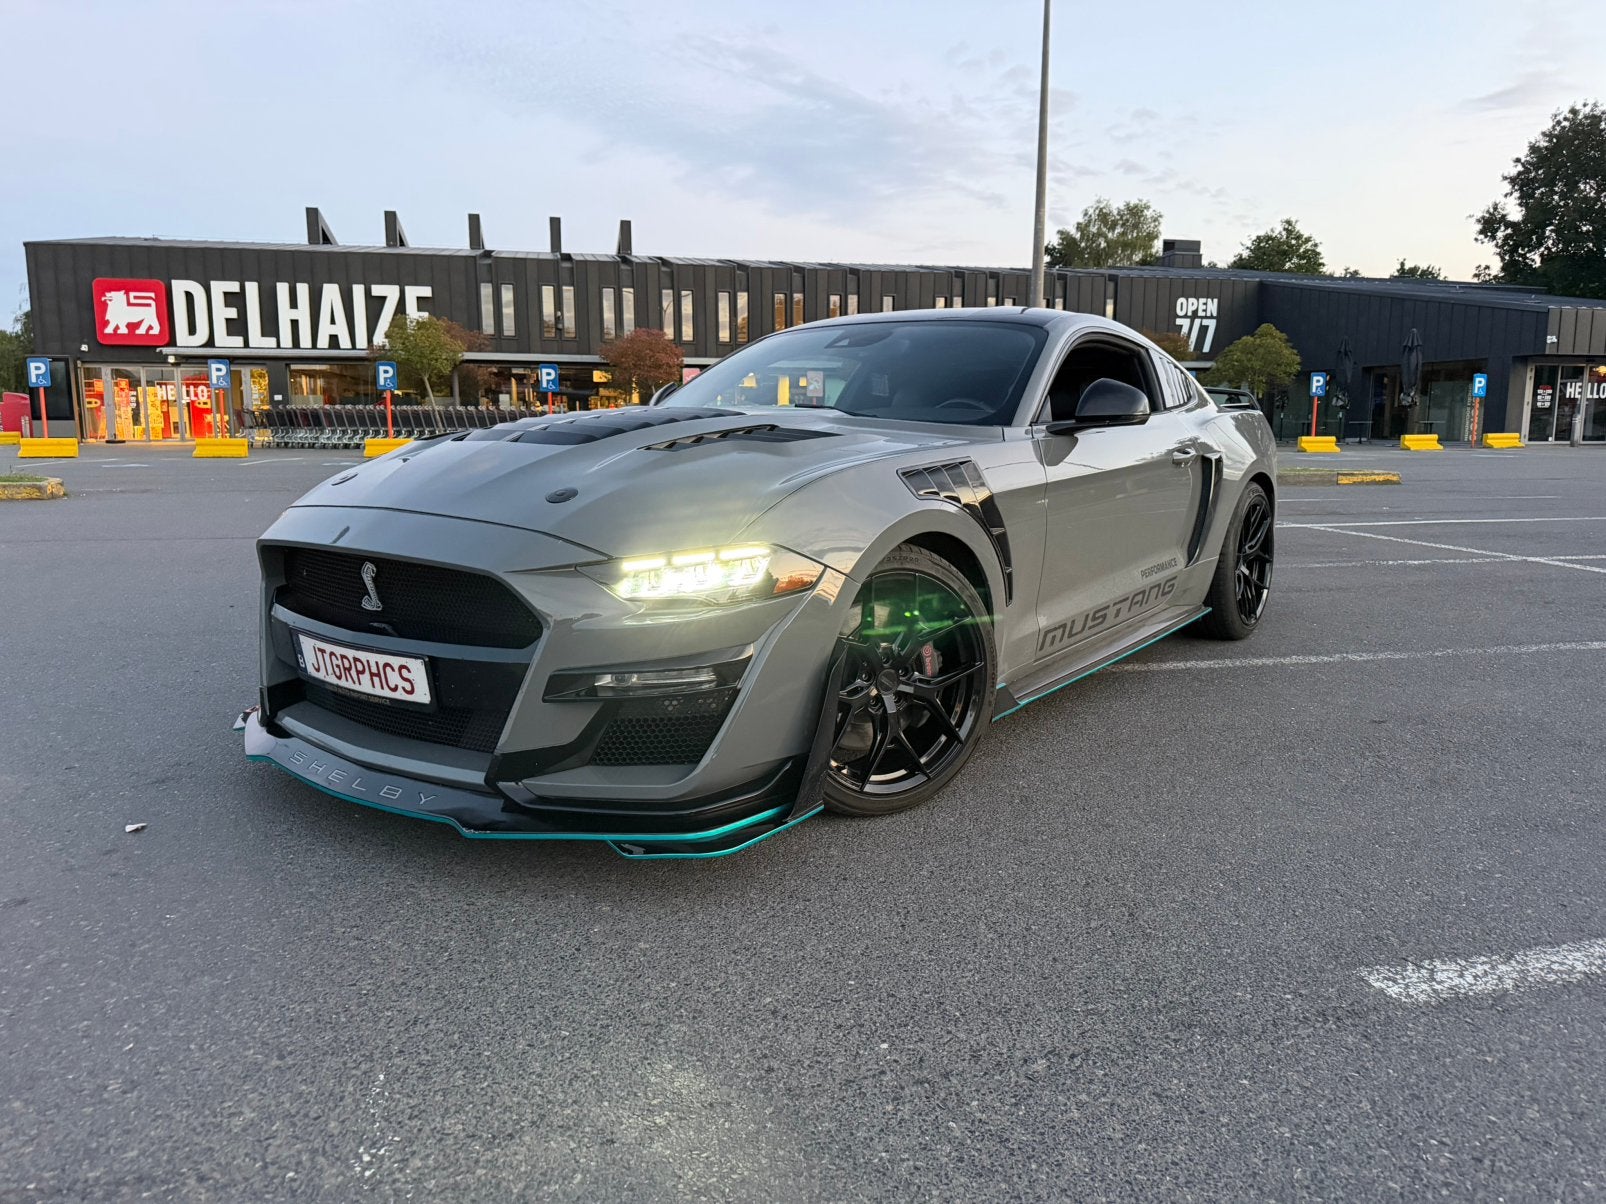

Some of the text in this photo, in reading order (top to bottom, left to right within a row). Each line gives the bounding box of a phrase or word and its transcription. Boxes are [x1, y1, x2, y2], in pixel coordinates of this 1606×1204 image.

[1176, 297, 1218, 317] OPEN
[1175, 318, 1217, 353] 7/7
[30, 362, 46, 383] P
[211, 363, 227, 384] P
[379, 365, 394, 386] P
[541, 368, 556, 388] P
[157, 384, 208, 401] HELLO
[1312, 376, 1324, 393] P
[1474, 377, 1485, 394] P
[1140, 557, 1178, 580] PERFORMANCE
[1039, 575, 1178, 653] MUSTANG
[312, 645, 416, 696] JTGRPHCS
[289, 751, 436, 805] SHELBY
